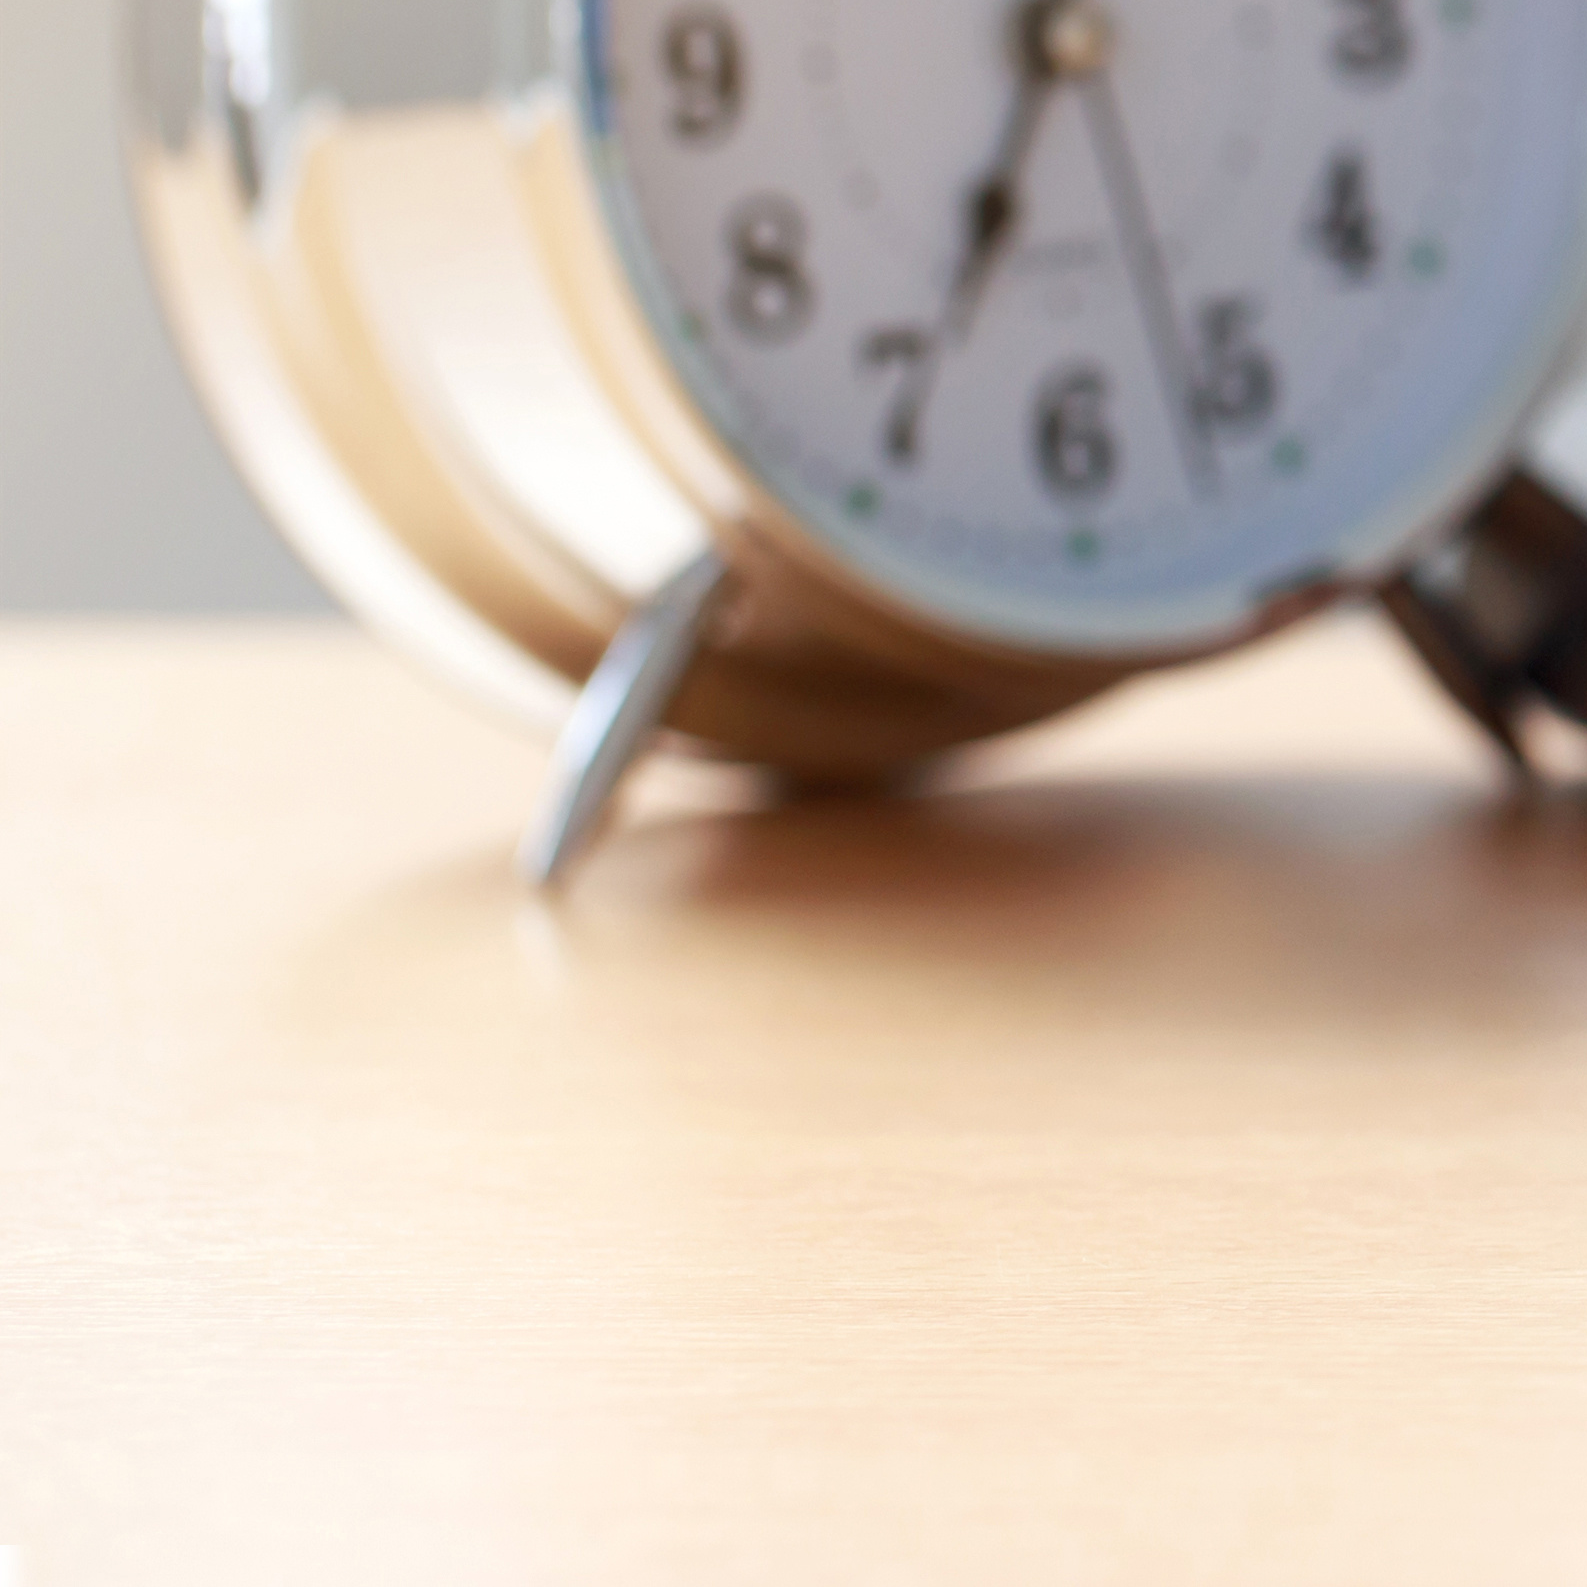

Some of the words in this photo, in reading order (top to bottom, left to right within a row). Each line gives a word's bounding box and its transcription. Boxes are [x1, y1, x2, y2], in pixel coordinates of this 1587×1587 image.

[664, 8, 740, 145] 9
[728, 201, 812, 338] 8
[1312, 151, 1372, 280] 4
[866, 329, 929, 460] 7
[1203, 302, 1273, 428] 5
[1035, 367, 1113, 495] 6
